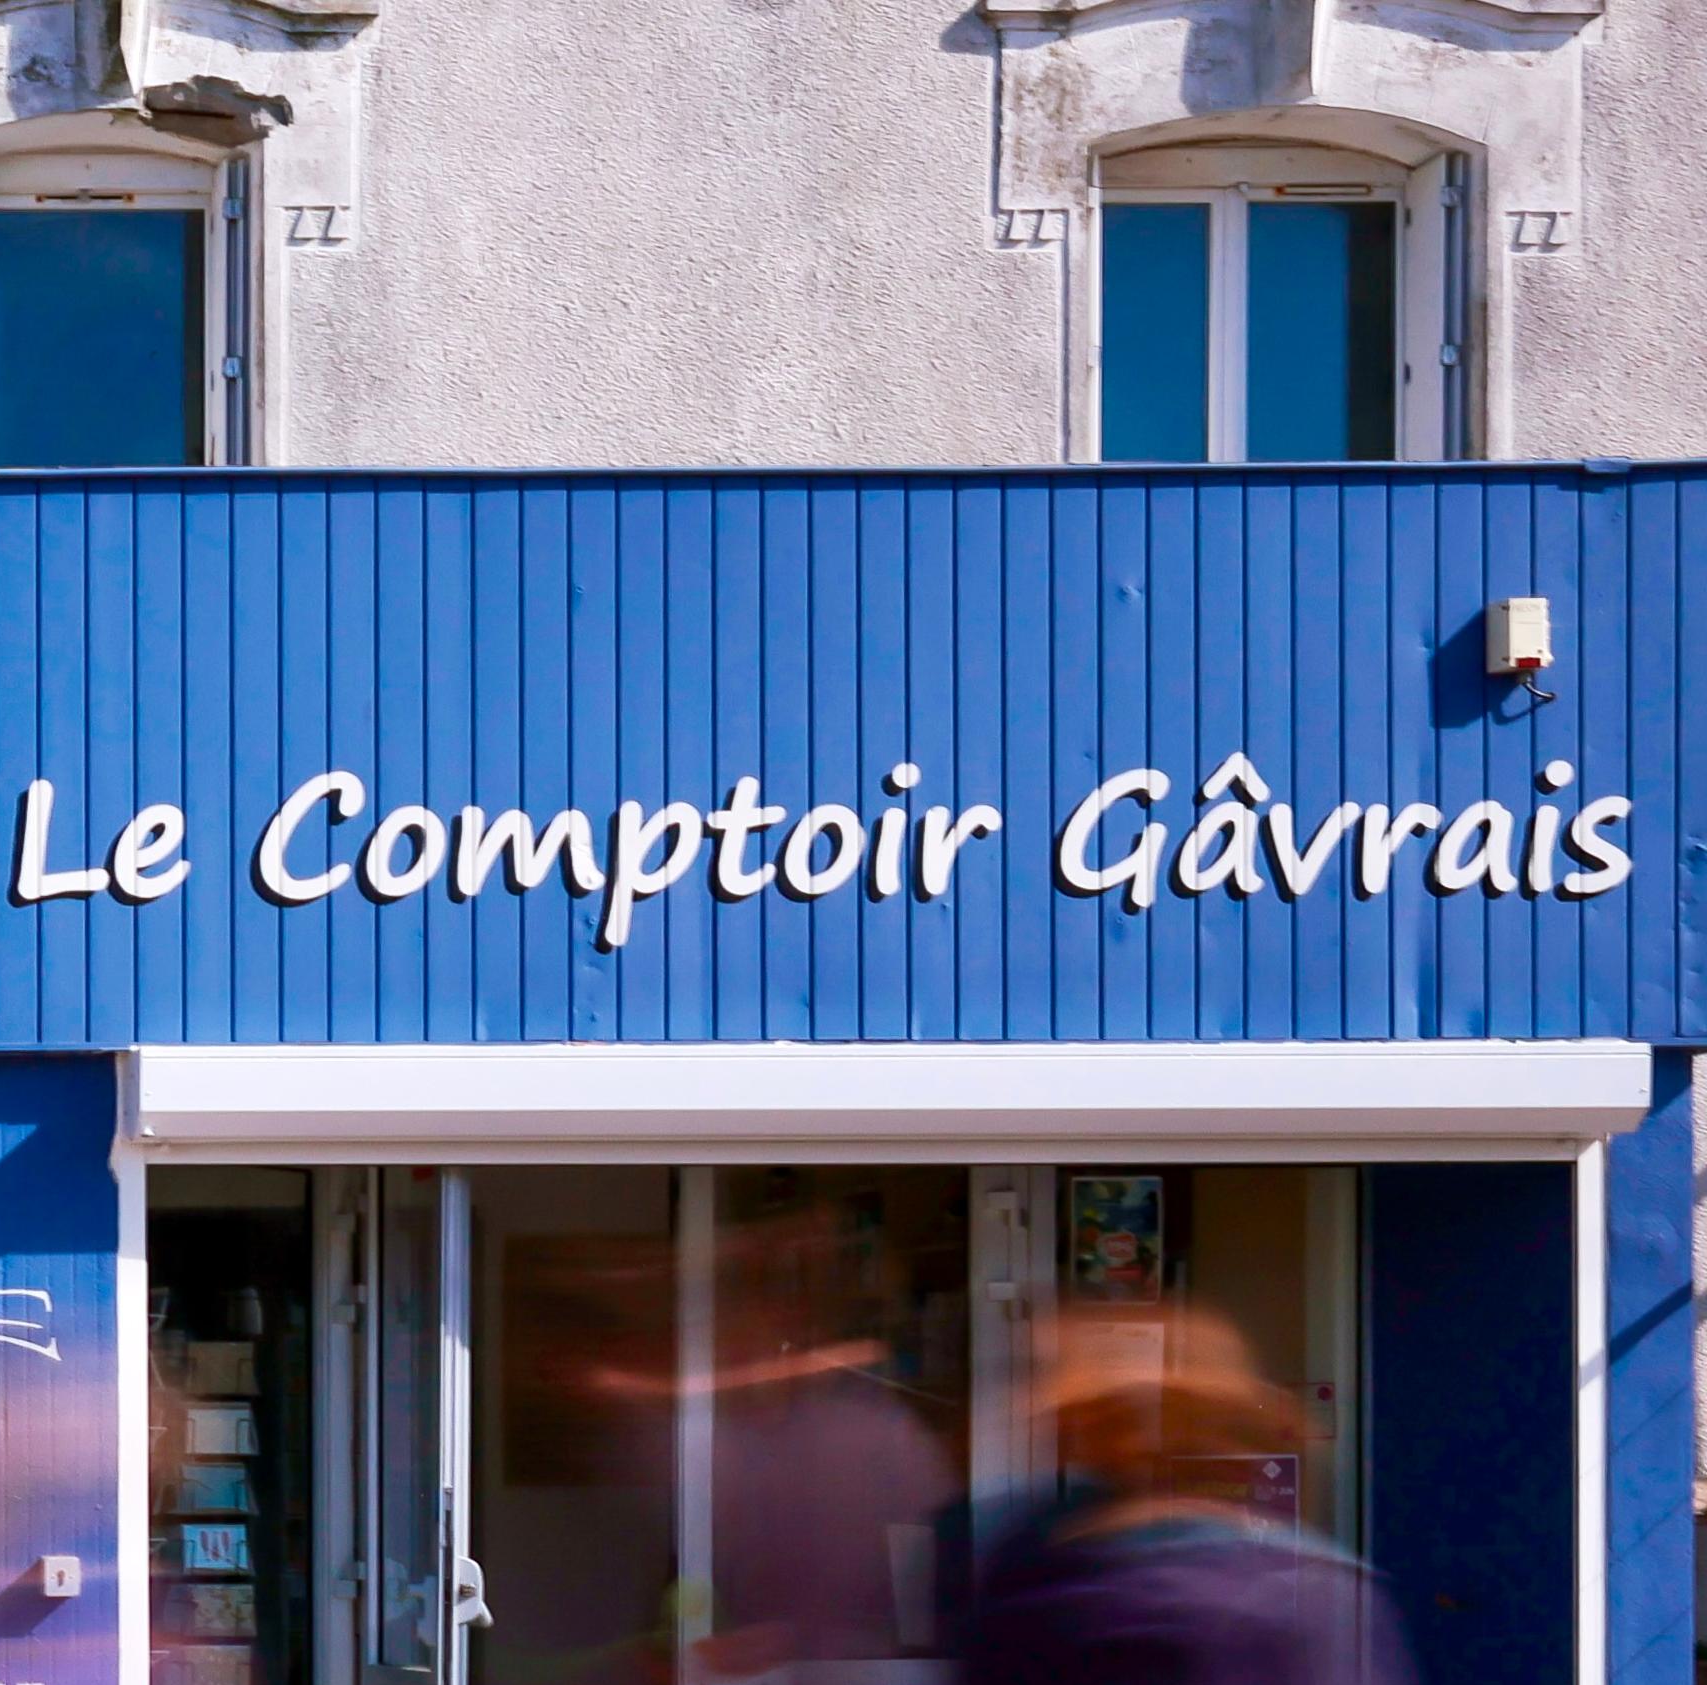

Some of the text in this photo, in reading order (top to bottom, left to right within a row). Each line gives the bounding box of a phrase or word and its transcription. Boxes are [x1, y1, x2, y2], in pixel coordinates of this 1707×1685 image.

[17, 751, 1633, 947] Le Comptoir Gâvrais
